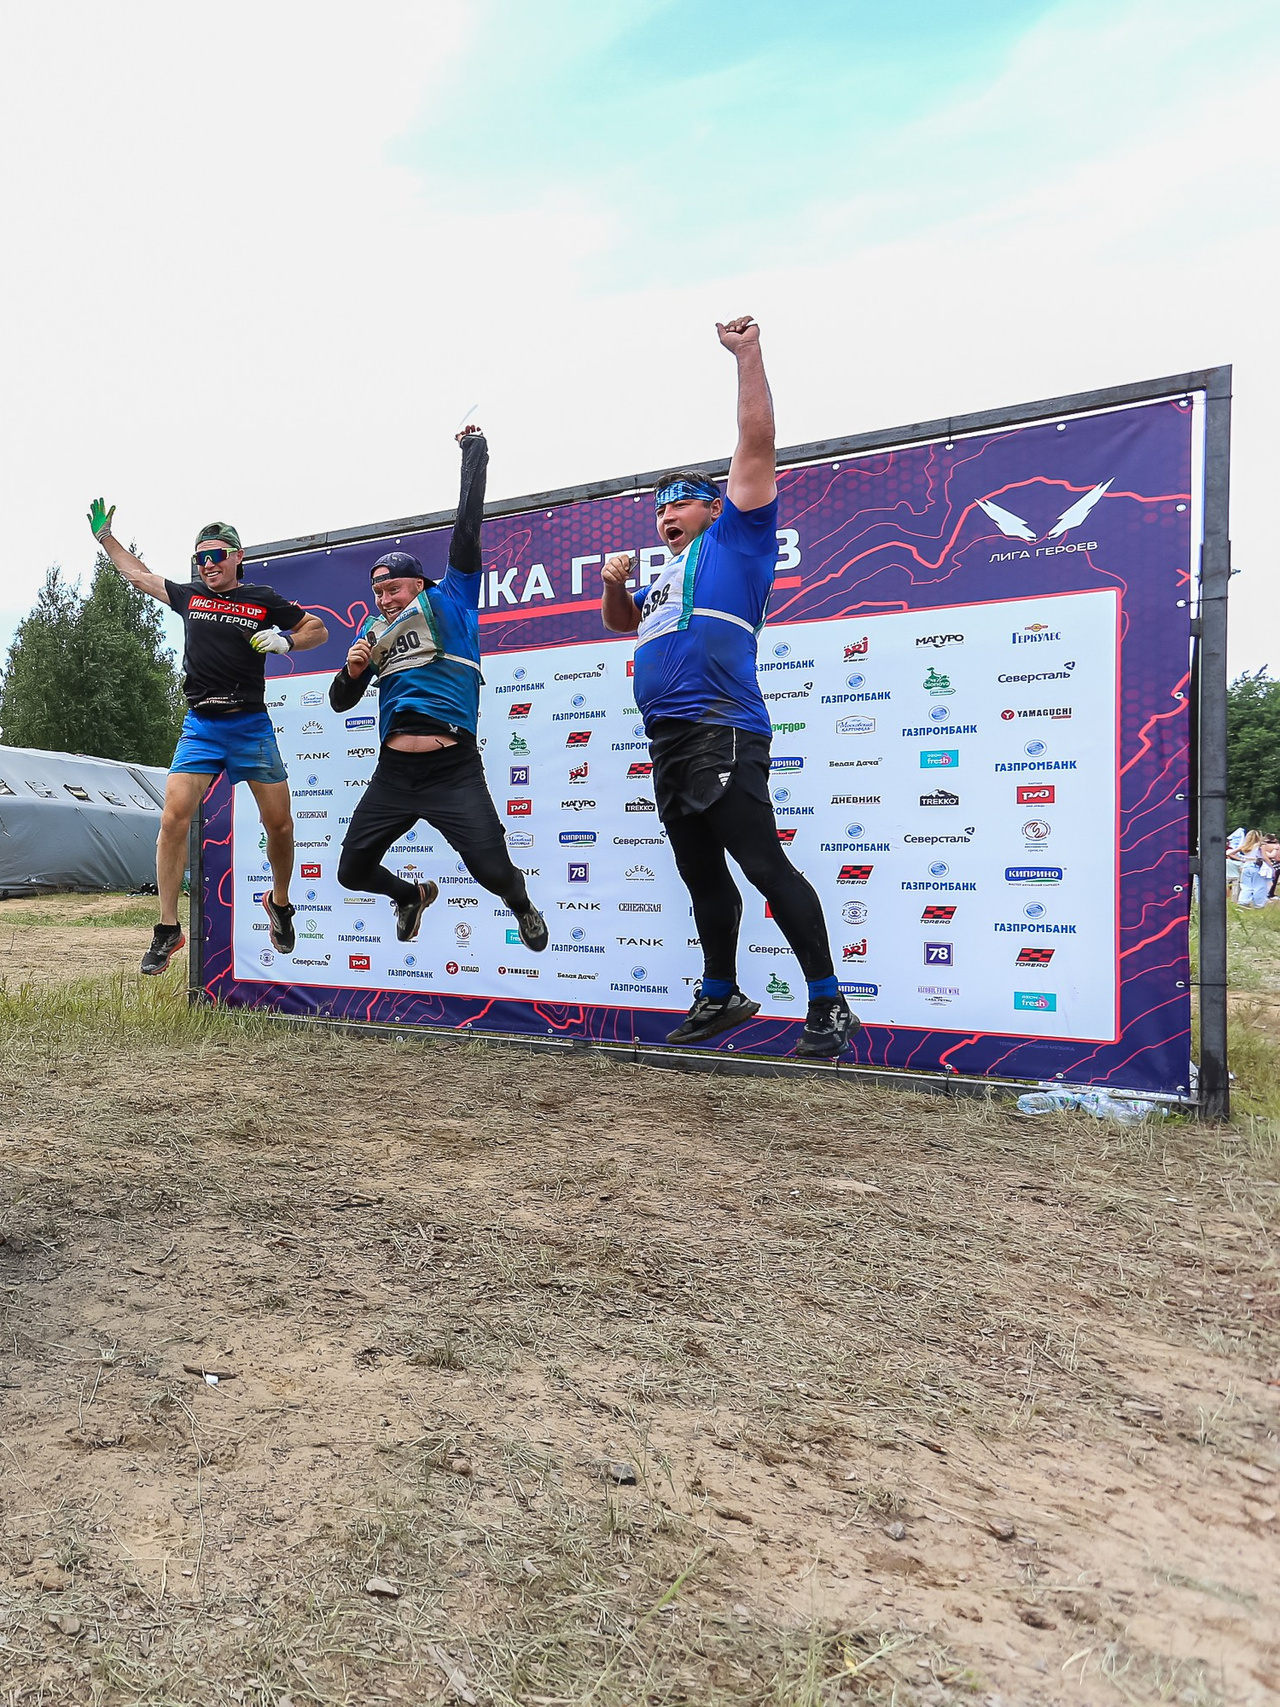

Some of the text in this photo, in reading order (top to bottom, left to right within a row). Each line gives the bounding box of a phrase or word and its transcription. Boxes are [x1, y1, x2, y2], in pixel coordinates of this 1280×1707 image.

[988, 541, 1099, 563] ЛИГА ГЕРОЕВ
[191, 597, 263, 617] ИНСТРУКТОР
[188, 611, 260, 631] ГОНКА ГЕРОЕВ
[915, 633, 965, 647] МАГУРО
[554, 670, 602, 682] Северсталь
[997, 670, 1071, 684] Северсталь
[495, 682, 545, 694] ГАЗПРОМБАНК
[821, 690, 891, 704] ГАЗПРОМБАНК
[552, 710, 607, 721] ГАЗПРОМБАНК
[1017, 707, 1072, 718] YAMAGUCHI
[902, 724, 978, 737] ГАЗПРОМБАНК
[611, 741, 649, 751] ГАЗПРОМ
[296, 751, 331, 761] TANK
[994, 760, 1078, 773] ГАЗПРОМБАНК
[513, 770, 527, 782] 78
[343, 779, 373, 787] TAN
[830, 795, 881, 805] ДНЕВНИК
[613, 836, 665, 847] Северсталь
[903, 833, 971, 846] Северсталь
[820, 843, 891, 852] ГАЗПРОМБАНК
[571, 867, 586, 879] 78
[624, 864, 655, 878] CLEENY
[1008, 869, 1060, 879] КИПРИНО
[901, 881, 977, 891] ГАЗПРОМБАНК
[556, 901, 601, 911] TANK
[994, 922, 1077, 934] ГАЗПРОМБАНК
[337, 934, 382, 944] ГАЗПРОМБАНК
[616, 937, 664, 947] TANK
[551, 943, 606, 954] ГАЗПРОМБАНК
[928, 947, 949, 961] 78
[292, 957, 329, 967] Северсталь
[388, 968, 434, 979] ГАЗПРОМБАНК
[610, 982, 669, 994] ГАЗПРОМБАНК
[1021, 998, 1046, 1008] fresh
